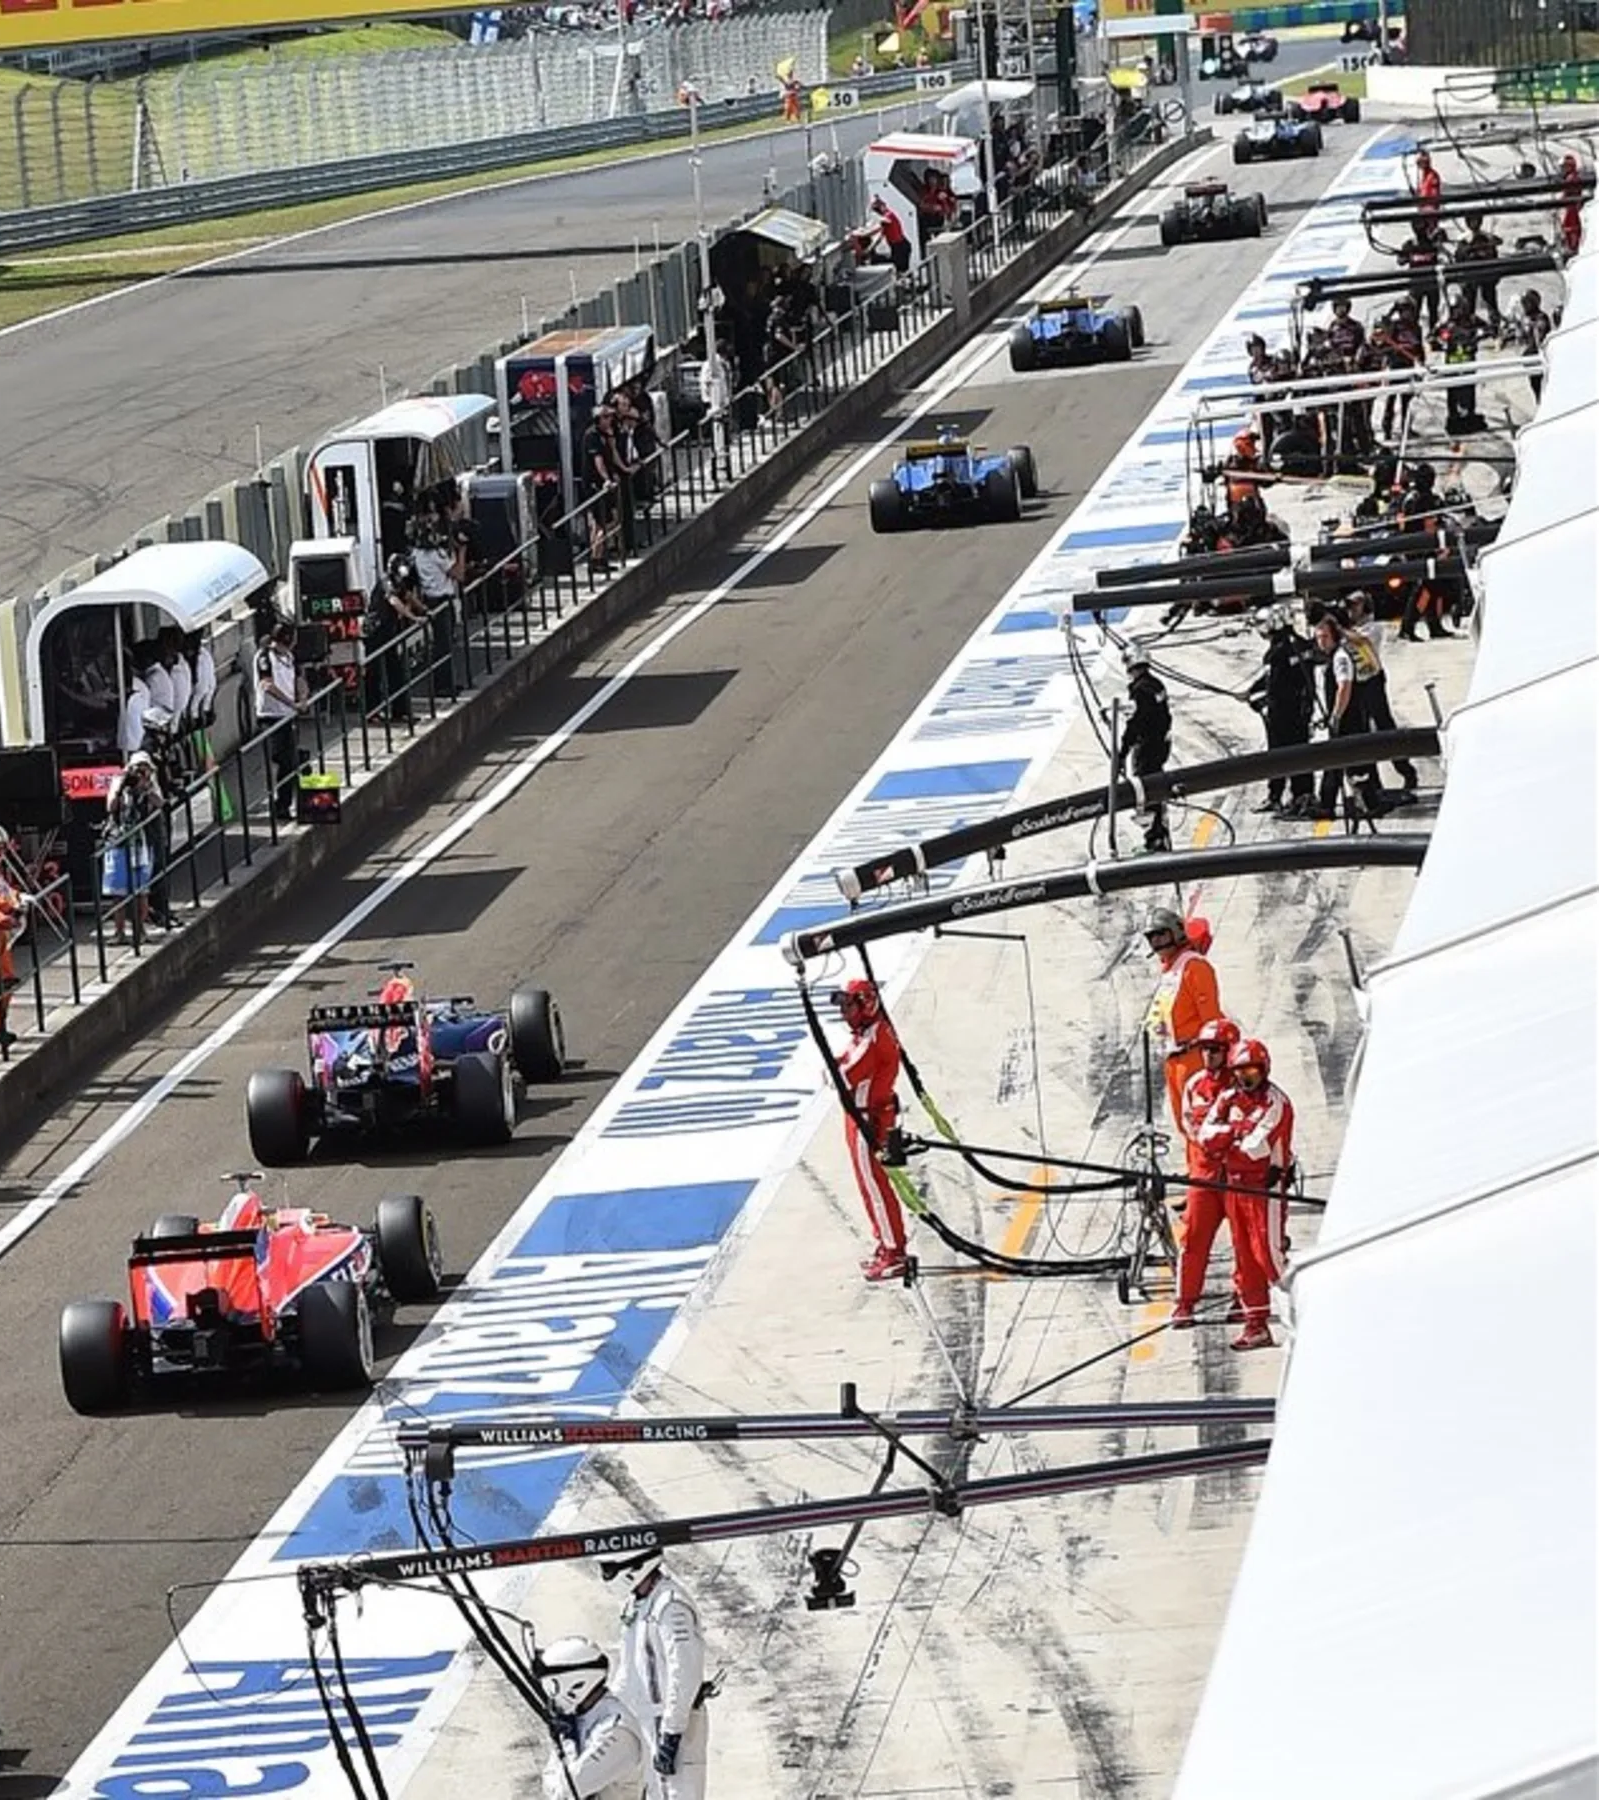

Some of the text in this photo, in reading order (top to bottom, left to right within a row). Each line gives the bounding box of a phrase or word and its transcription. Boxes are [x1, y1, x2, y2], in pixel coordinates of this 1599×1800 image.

[922, 75, 946, 89] 100
[401, 1245, 723, 1407] Allianz
[480, 1427, 564, 1443] WILLIAMS
[643, 1424, 708, 1440] RACING
[398, 1531, 658, 1577] WILLIAMS MARTINI RACING
